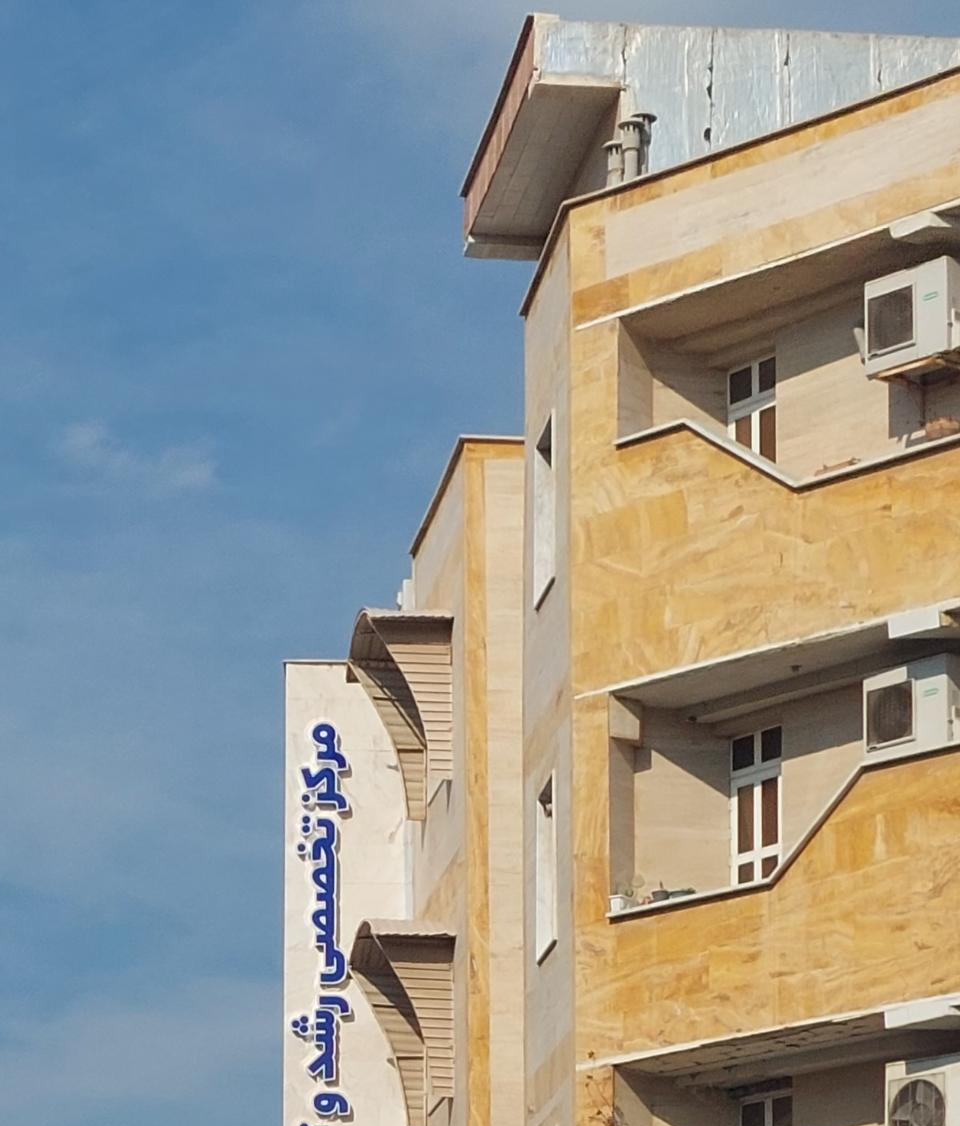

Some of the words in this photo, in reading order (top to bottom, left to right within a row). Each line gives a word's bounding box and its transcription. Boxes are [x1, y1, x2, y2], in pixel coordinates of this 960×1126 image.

[301, 723, 347, 810] مرکز
[298, 815, 347, 984] تخصصی
[291, 995, 350, 1080] رشد
[313, 1091, 350, 1114] و
